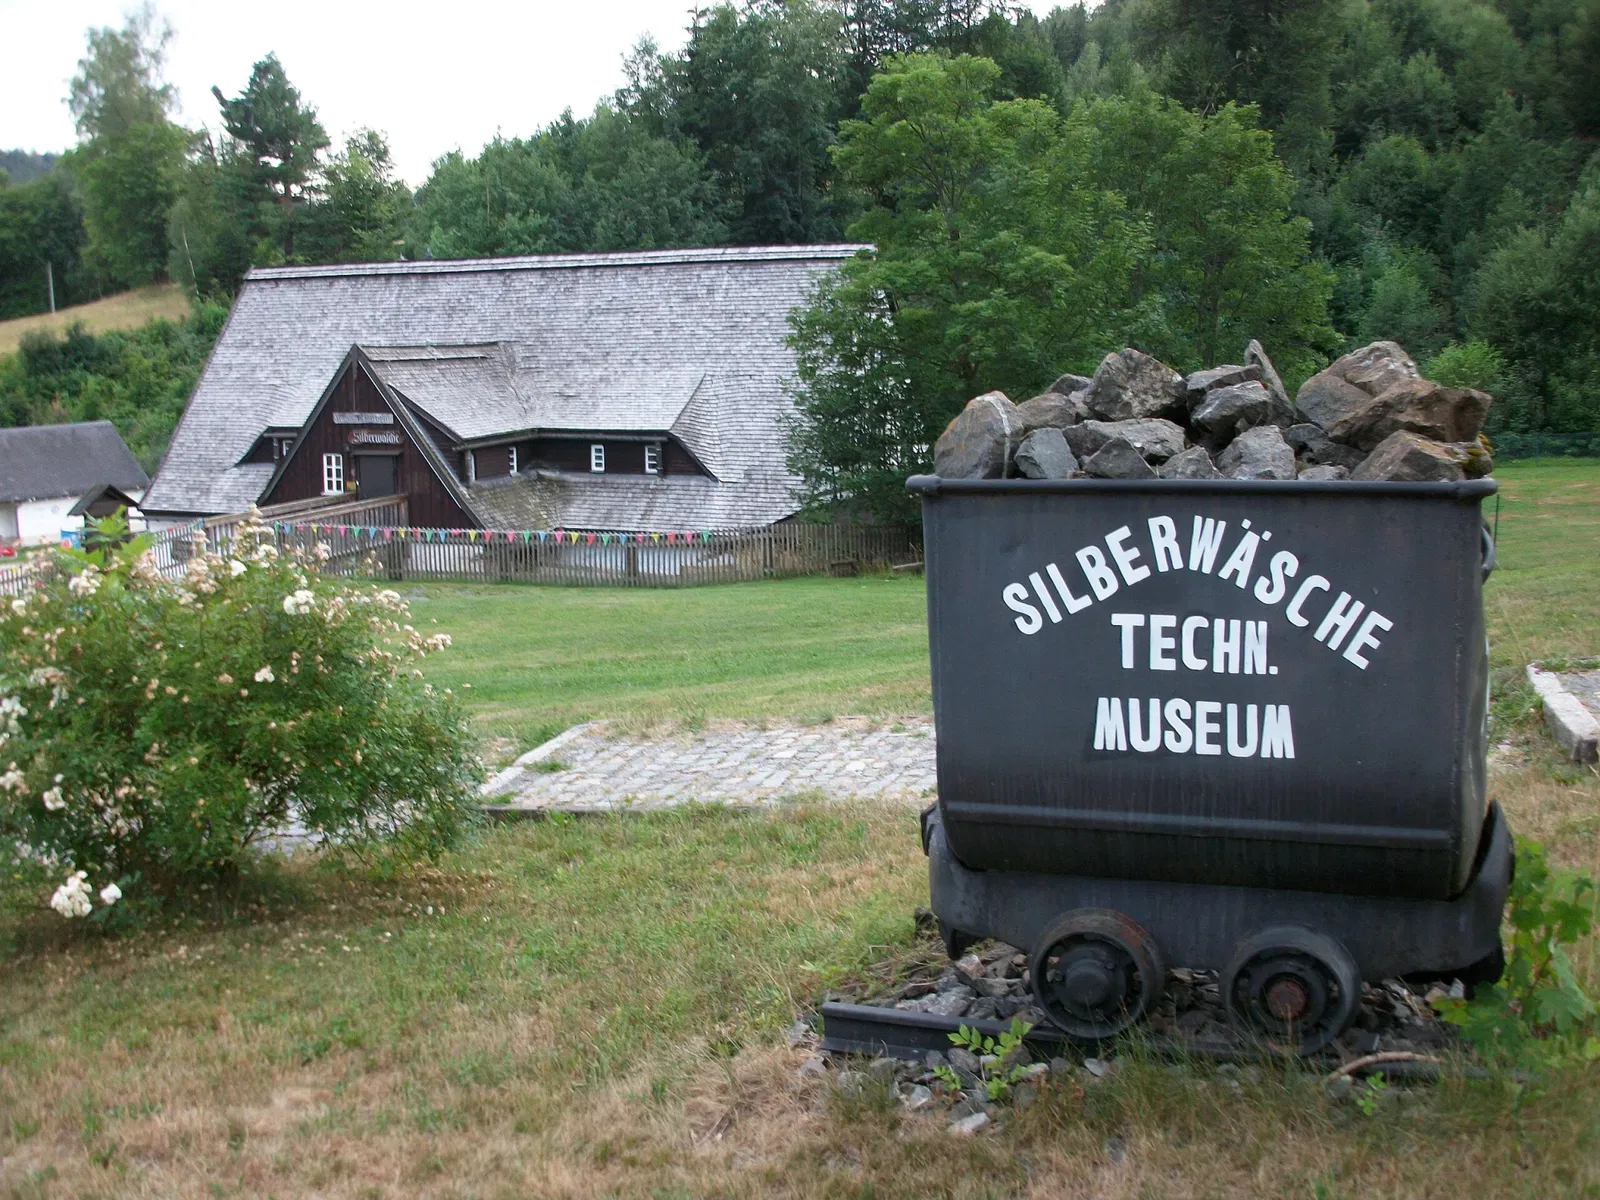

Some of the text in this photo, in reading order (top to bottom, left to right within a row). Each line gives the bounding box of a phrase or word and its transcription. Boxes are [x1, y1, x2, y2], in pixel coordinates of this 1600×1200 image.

[1002, 515, 1394, 670] SILBERWÄSCHE
[1111, 613, 1279, 675] TECHN.
[1093, 697, 1296, 759] MUSEUM
